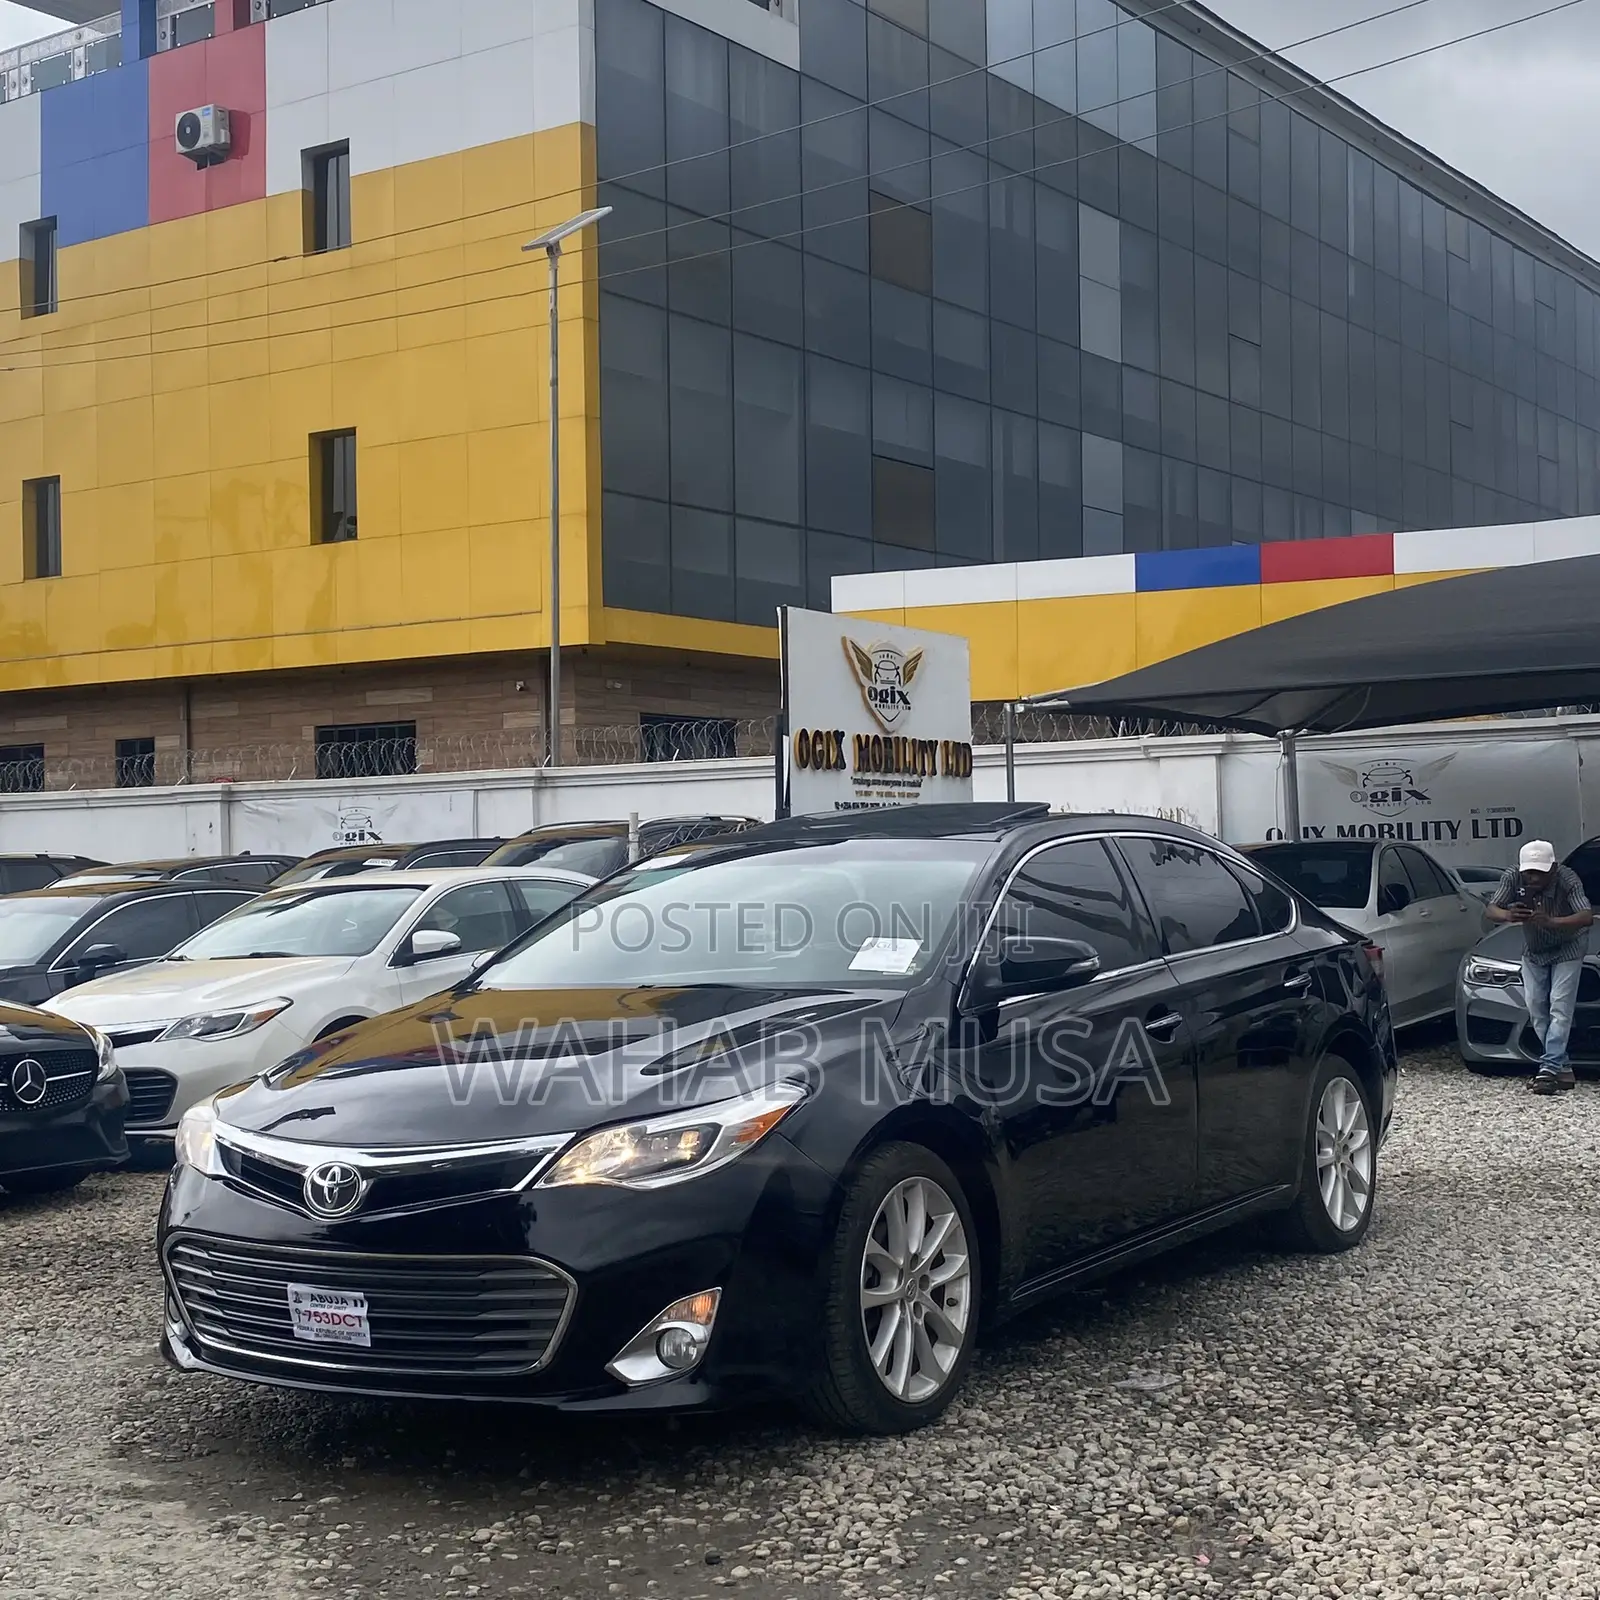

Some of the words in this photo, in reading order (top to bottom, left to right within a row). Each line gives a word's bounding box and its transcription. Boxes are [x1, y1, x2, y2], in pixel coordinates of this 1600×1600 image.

[794, 728, 846, 770] OGIX
[853, 733, 938, 777] MOBILITY
[940, 740, 973, 778] LTD
[1266, 825, 1326, 841] OIX
[1336, 820, 1461, 842] MOBILITY
[1471, 817, 1523, 839] LTD
[310, 1293, 349, 1306] ABUJA
